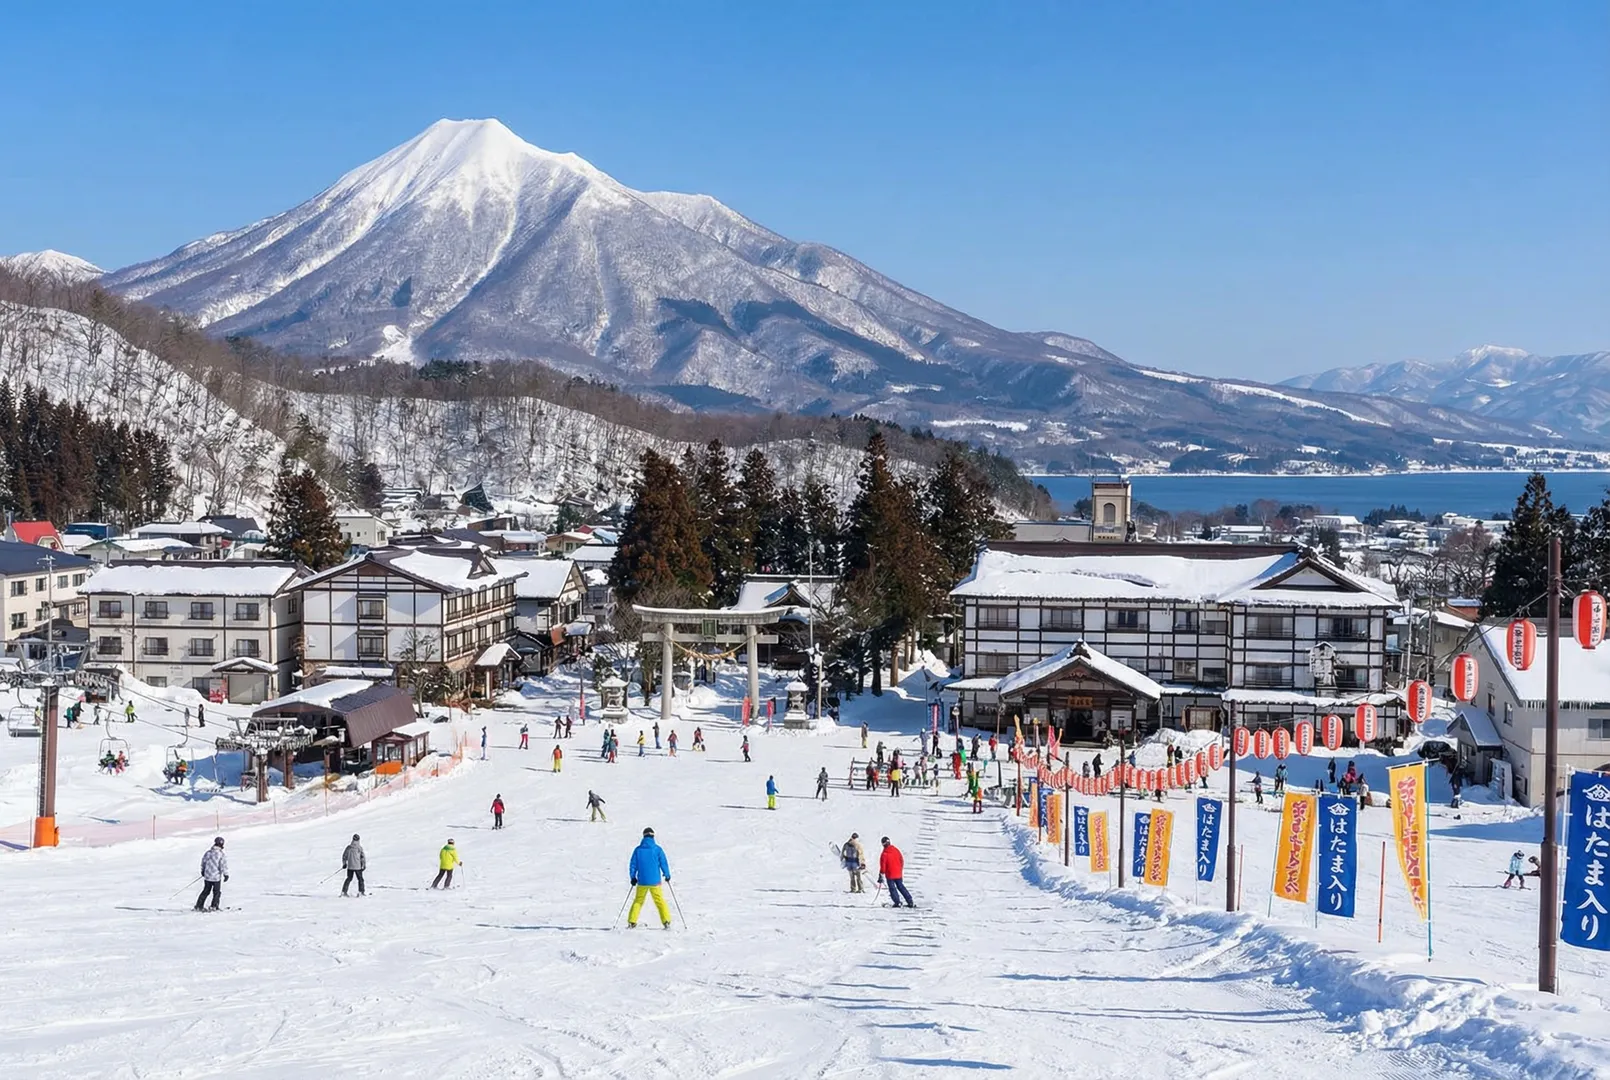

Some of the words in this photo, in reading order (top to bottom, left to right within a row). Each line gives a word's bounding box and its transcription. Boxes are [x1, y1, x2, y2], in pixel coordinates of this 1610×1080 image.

[1199, 814, 1214, 876] はたま入り
[1328, 817, 1348, 911] はたま入り
[1577, 804, 1610, 941] はたま入り
